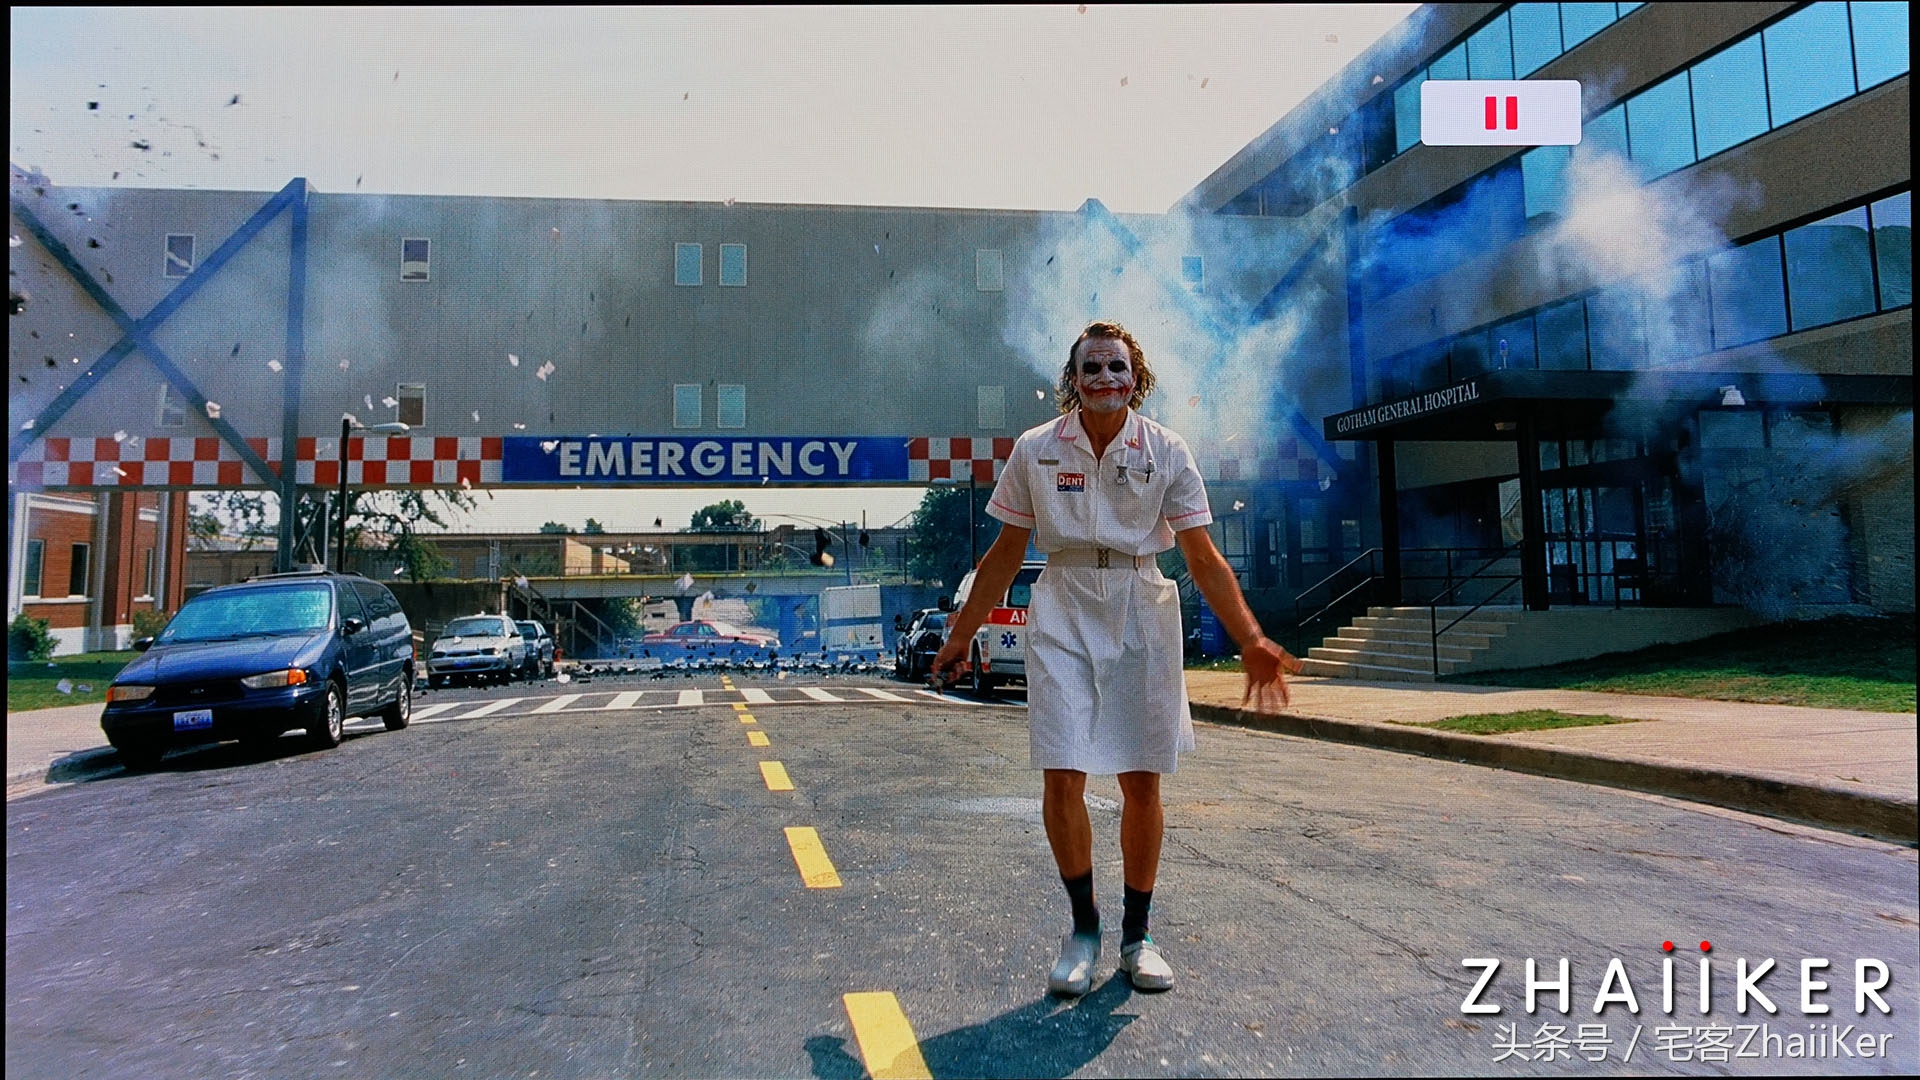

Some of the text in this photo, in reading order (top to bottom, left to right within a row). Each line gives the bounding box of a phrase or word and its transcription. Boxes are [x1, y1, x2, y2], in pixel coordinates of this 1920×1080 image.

[1337, 382, 1480, 433] GOTHAM GENERAL HOSPITAL
[559, 441, 858, 476] EMERGENCY
[1058, 475, 1083, 486] DENT
